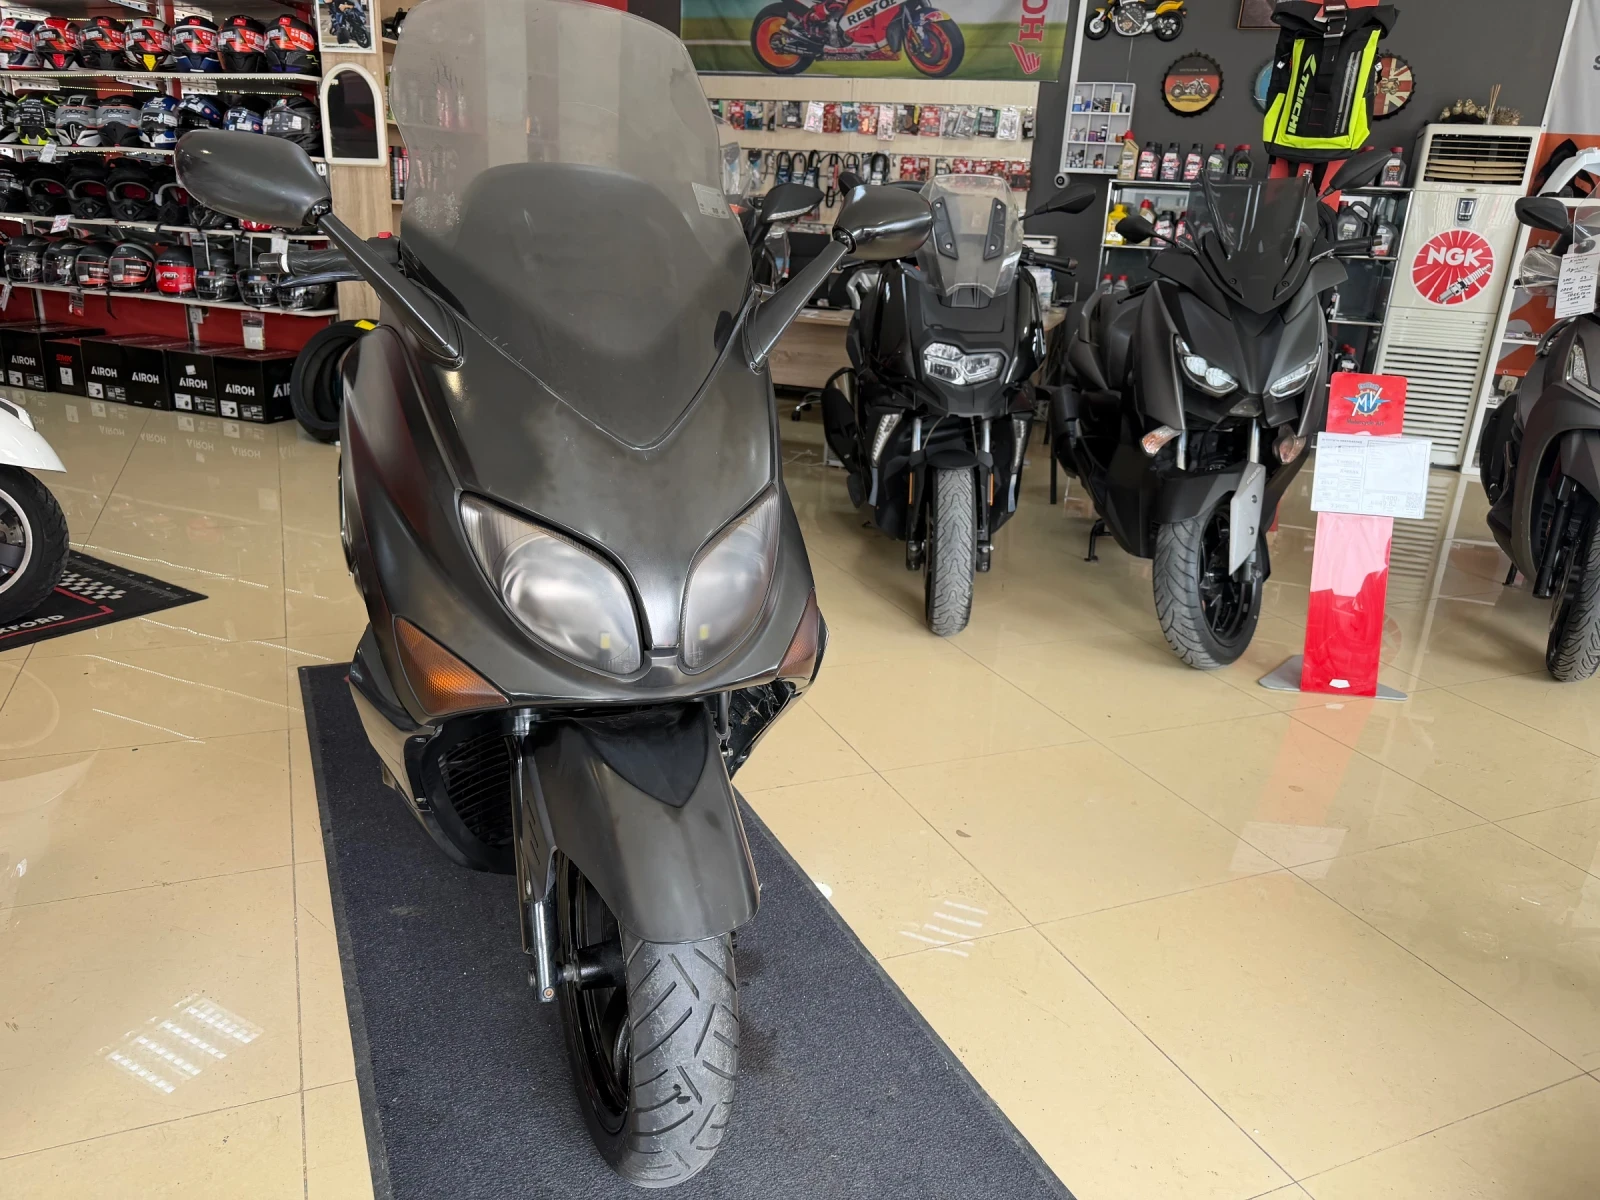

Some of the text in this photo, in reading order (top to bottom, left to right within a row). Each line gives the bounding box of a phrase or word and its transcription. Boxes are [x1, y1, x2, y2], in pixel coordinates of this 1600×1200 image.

[1287, 73, 1310, 134] TAICHI
[1426, 246, 1484, 268] NGK
[11, 354, 36, 366] AIROH
[56, 353, 73, 362] SMK
[91, 365, 118, 378] AIROH
[132, 371, 160, 384] AIROH
[179, 377, 208, 390] AIROH
[225, 383, 255, 396] AIROH
[1351, 387, 1383, 417] MV
